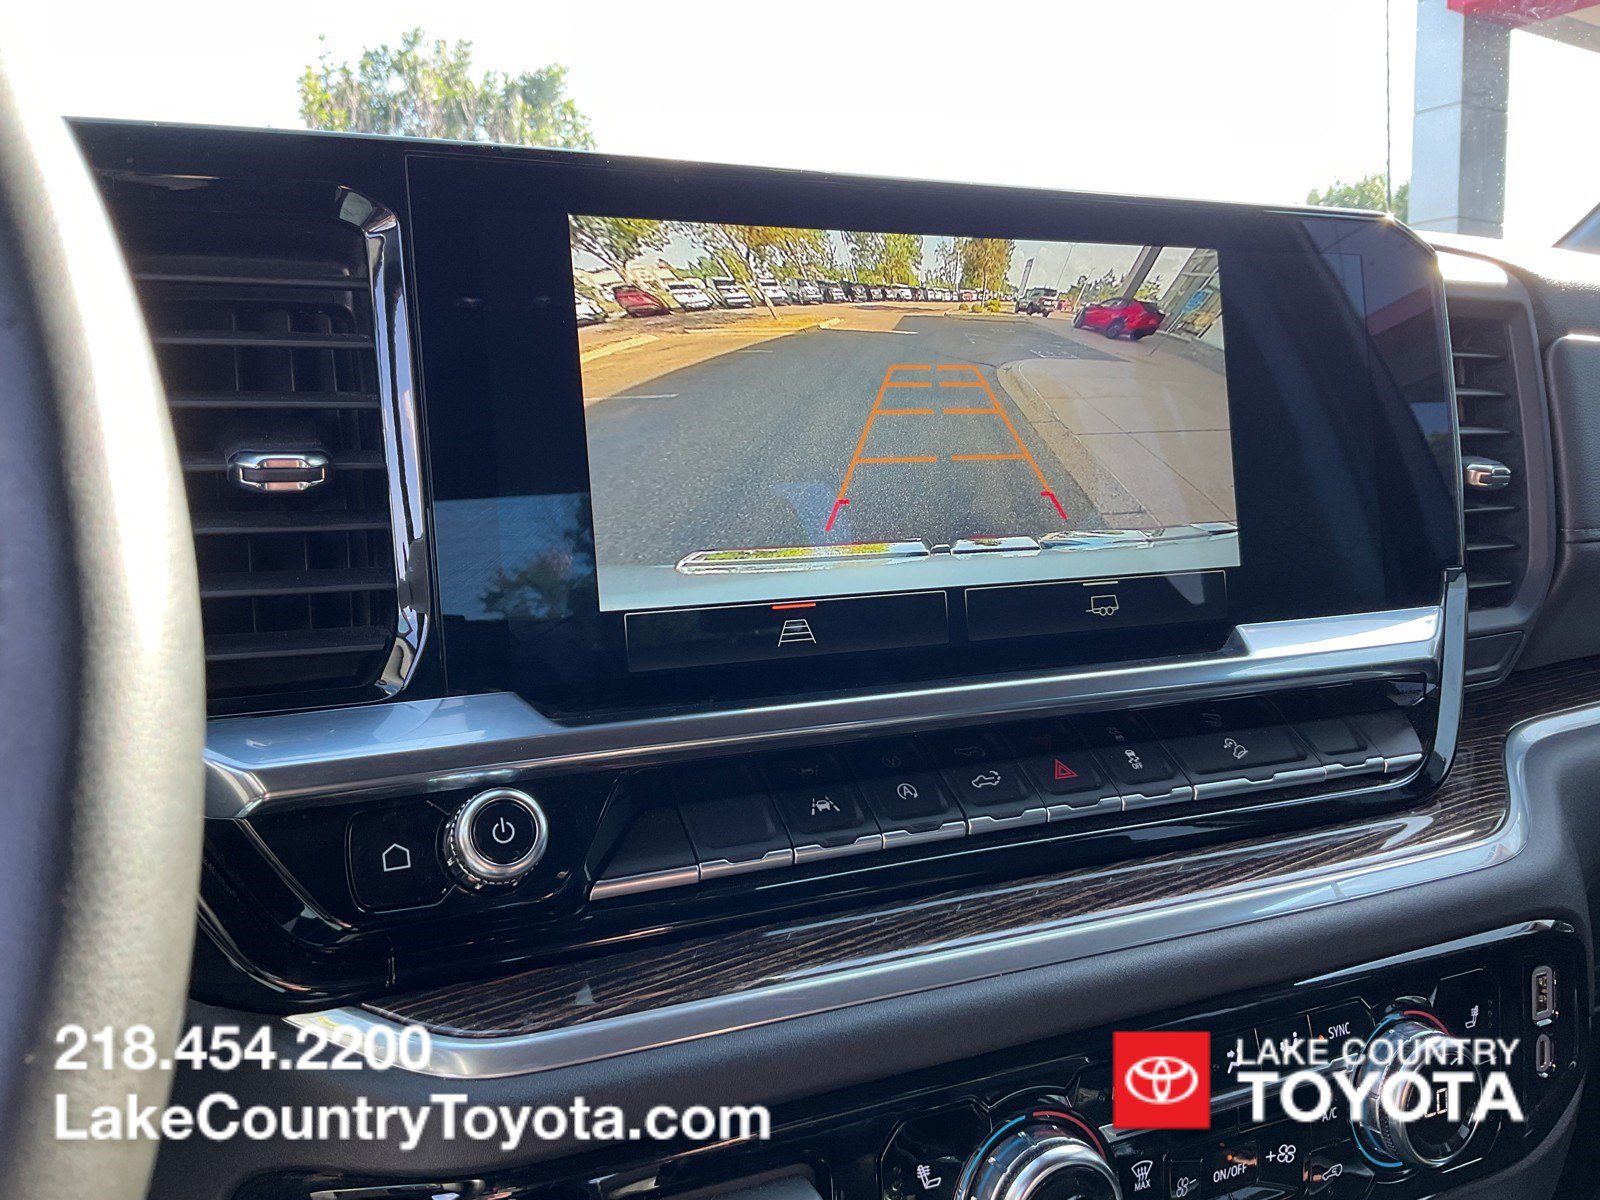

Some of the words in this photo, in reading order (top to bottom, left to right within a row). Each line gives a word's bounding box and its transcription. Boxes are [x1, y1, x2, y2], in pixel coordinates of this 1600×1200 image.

[1328, 1022, 1351, 1039] SYNC
[1213, 1164, 1247, 1183] ON/OFF
[1134, 1178, 1151, 1192] MAX
